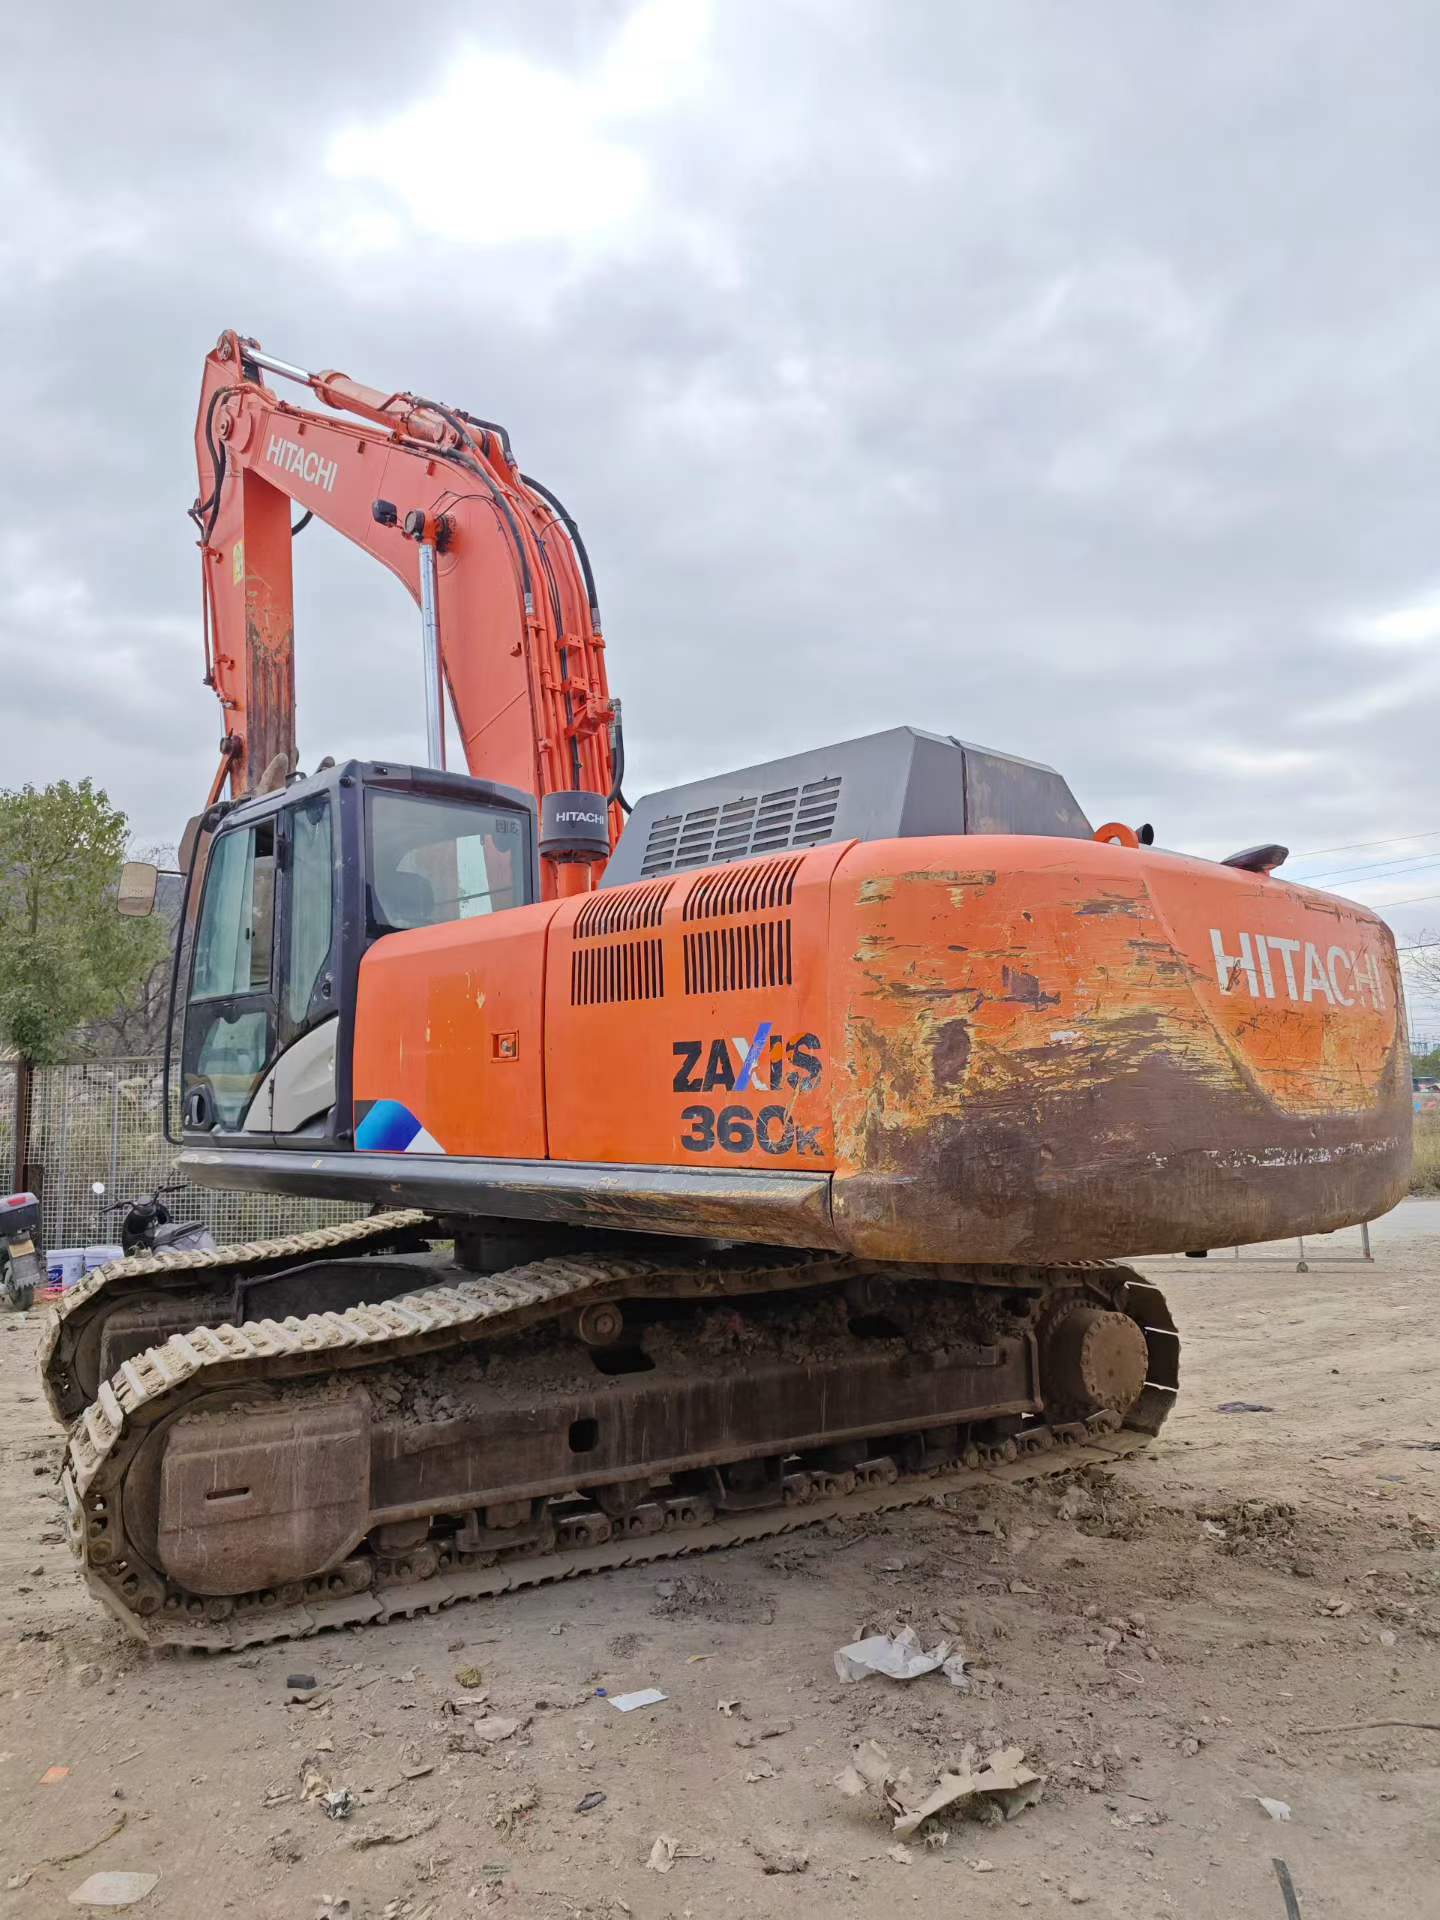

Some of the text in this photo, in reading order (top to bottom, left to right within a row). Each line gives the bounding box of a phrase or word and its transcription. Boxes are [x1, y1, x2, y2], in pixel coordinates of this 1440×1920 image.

[266, 434, 338, 492] HITACHI
[556, 811, 604, 825] HITACHI
[1209, 928, 1387, 1009] HITACHI
[672, 1022, 823, 1092] ZAXIS
